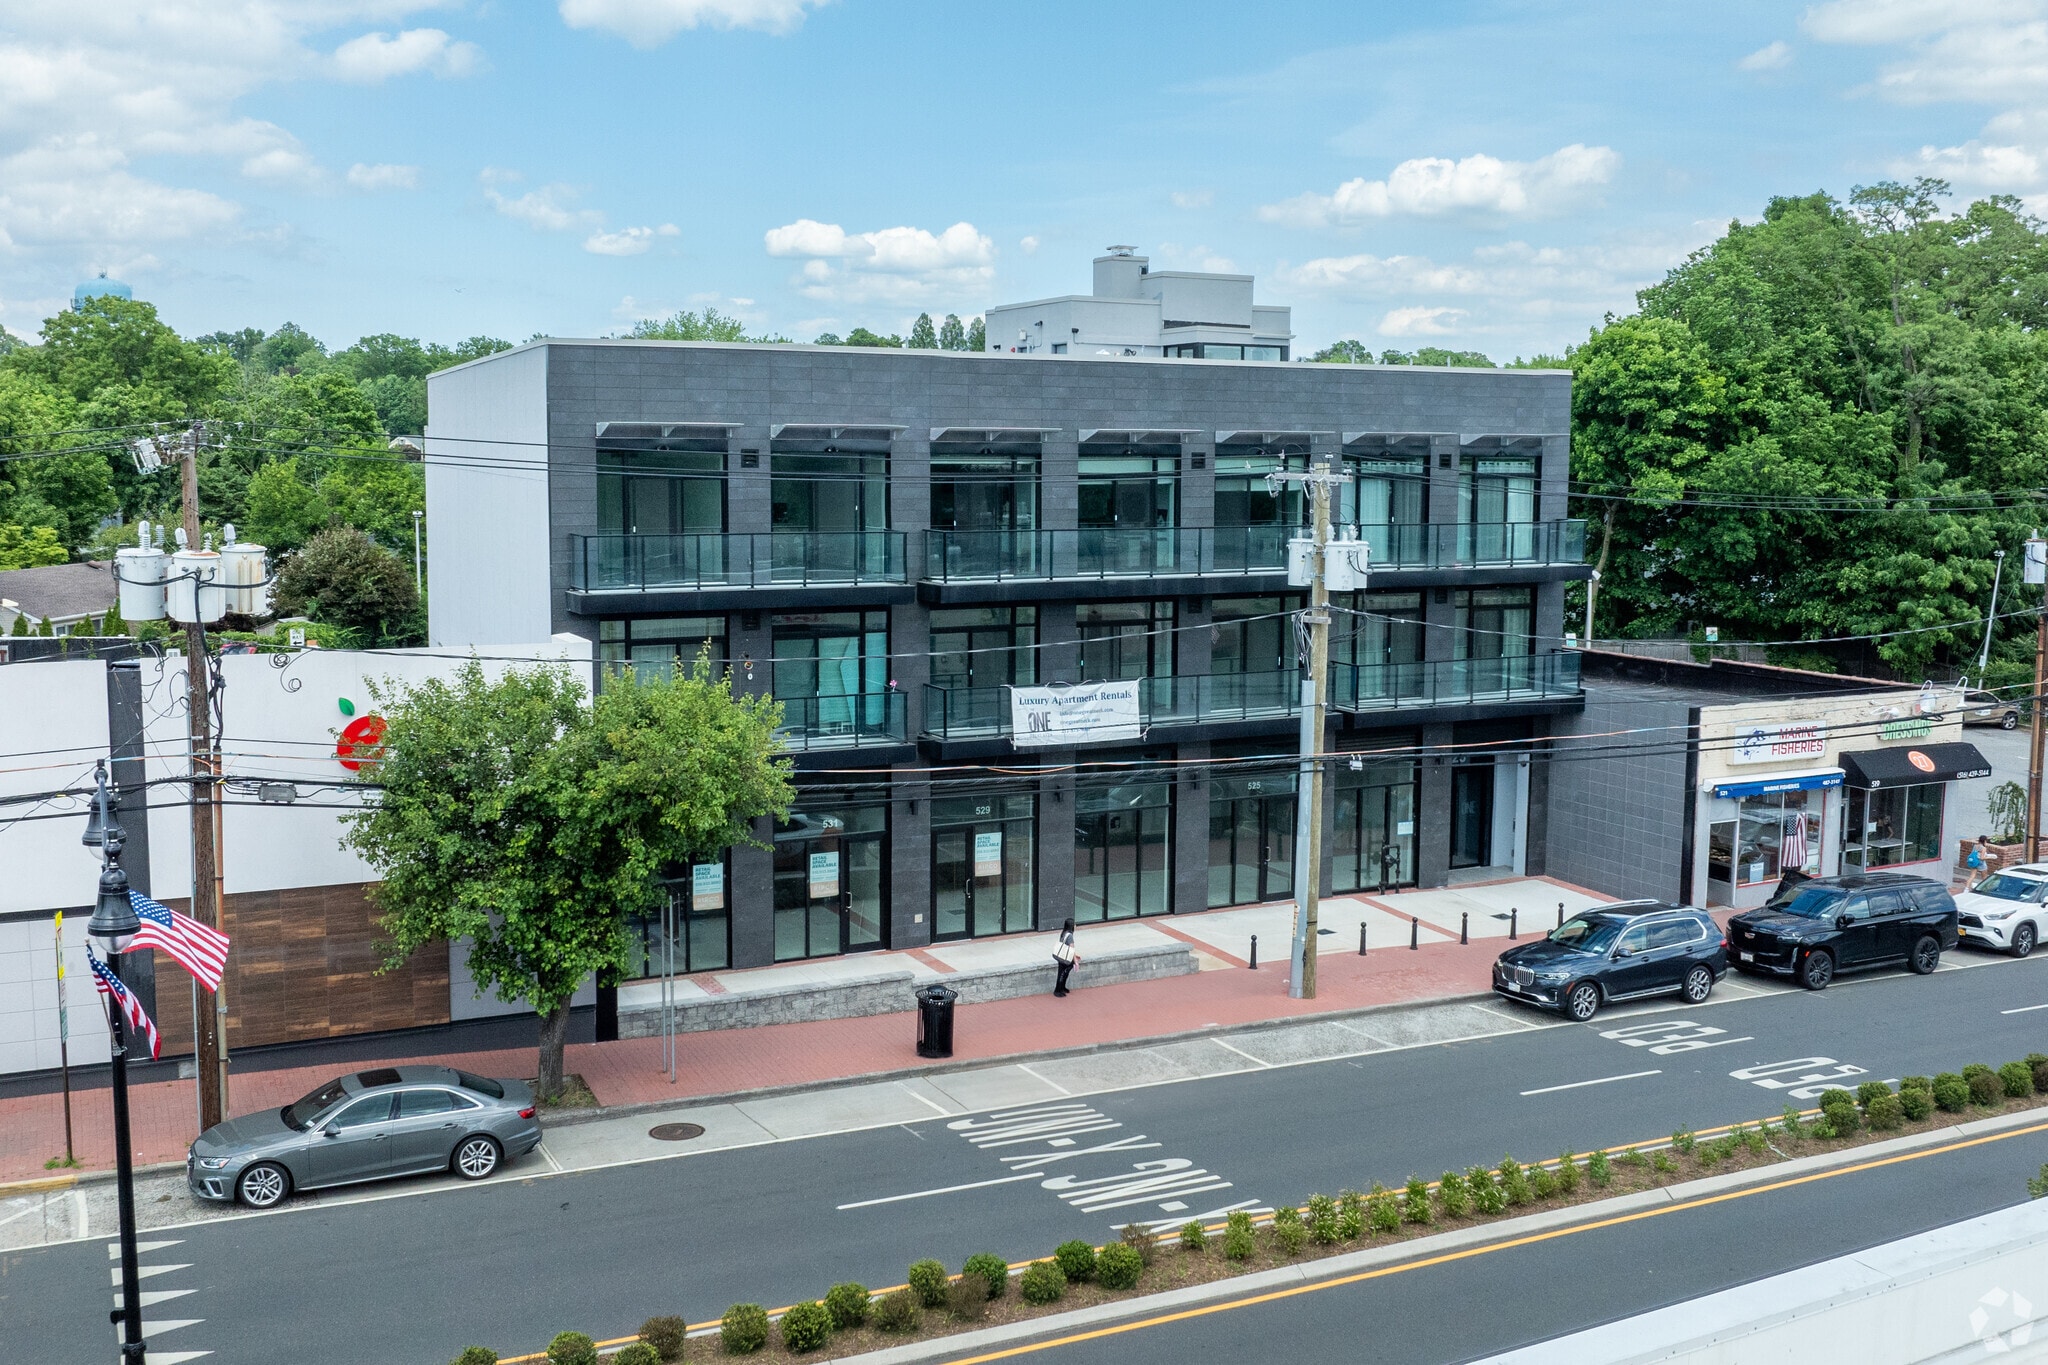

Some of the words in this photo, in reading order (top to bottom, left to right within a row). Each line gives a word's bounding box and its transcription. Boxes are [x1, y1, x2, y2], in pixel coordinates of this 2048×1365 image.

[1019, 697, 1049, 706] Luxury
[1052, 693, 1098, 706] Apartment
[1101, 690, 1132, 700] Rentals
[1028, 712, 1052, 732] ONE
[1779, 726, 1818, 740] MARINE
[1772, 740, 1824, 755] FISHERIES
[1247, 781, 1261, 790] 525
[975, 806, 991, 815] 529
[822, 819, 839, 829] 531
